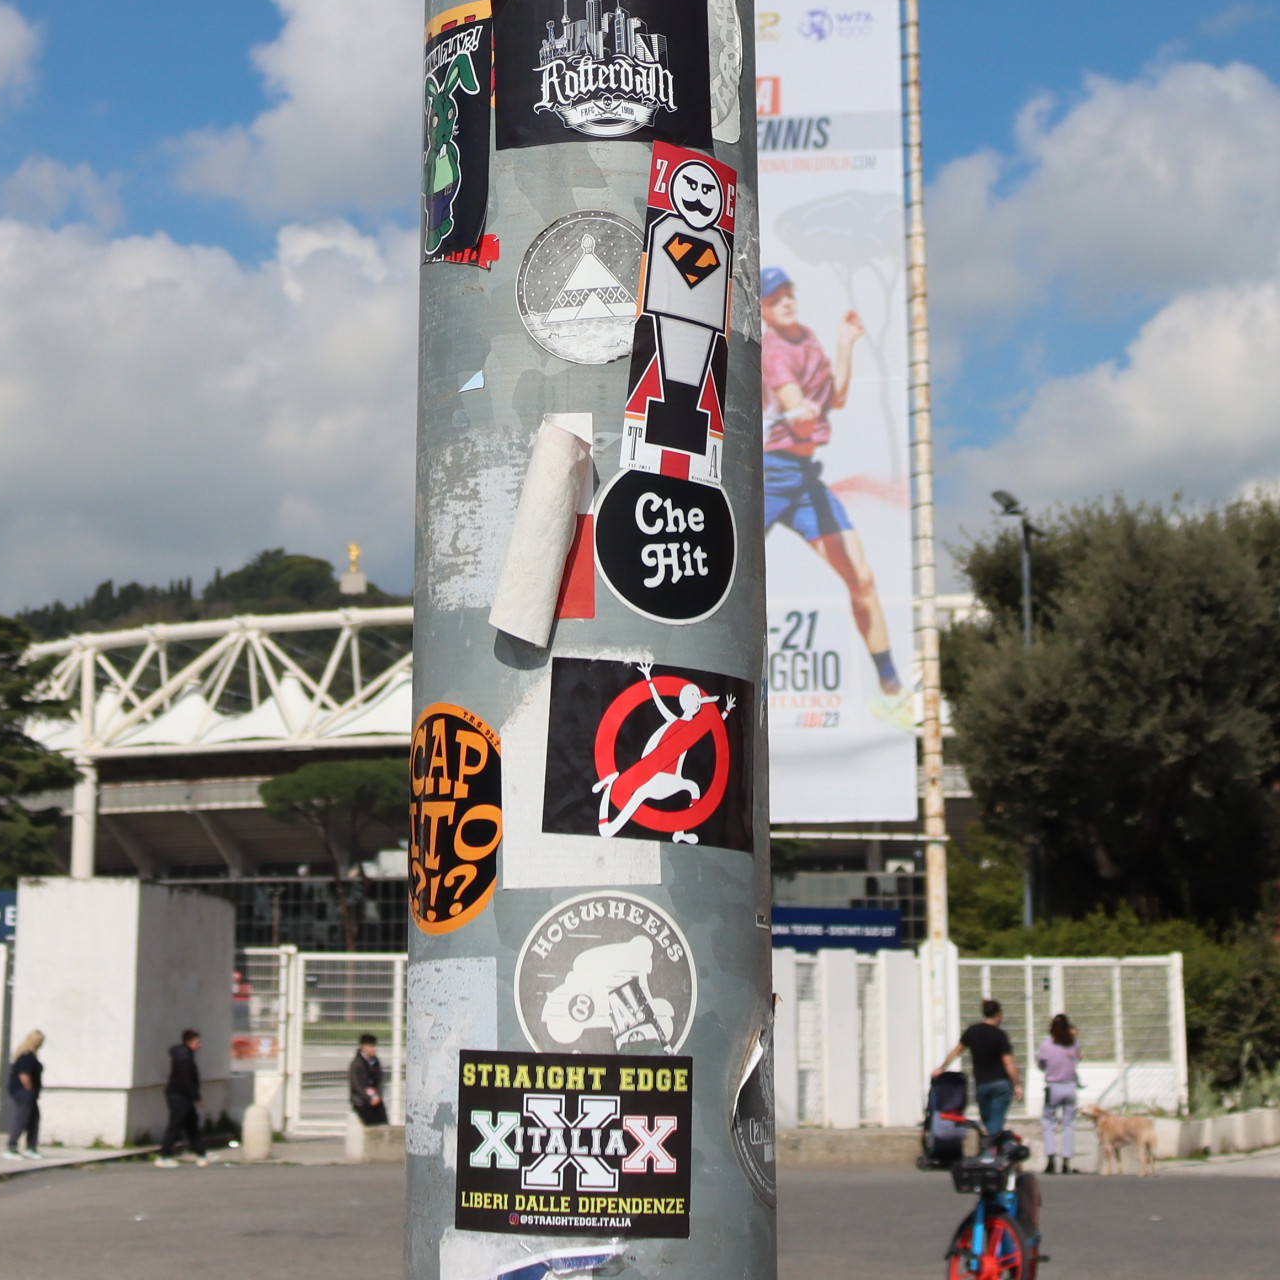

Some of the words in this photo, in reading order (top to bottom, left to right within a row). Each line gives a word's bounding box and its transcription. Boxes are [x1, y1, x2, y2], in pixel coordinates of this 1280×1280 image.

[635, 491, 705, 535] Che
[641, 541, 709, 588] Hit
[462, 1063, 607, 1091] STRAIGHT
[619, 1067, 688, 1093] EDGE
[514, 1126, 627, 1156] ITALIA
[461, 1191, 509, 1210] LIBERI
[515, 1194, 571, 1213] DALLE
[578, 1197, 685, 1215] DIPENDENZE
[520, 1214, 632, 1228] @STRAIGHTEDGE.ITALIA
